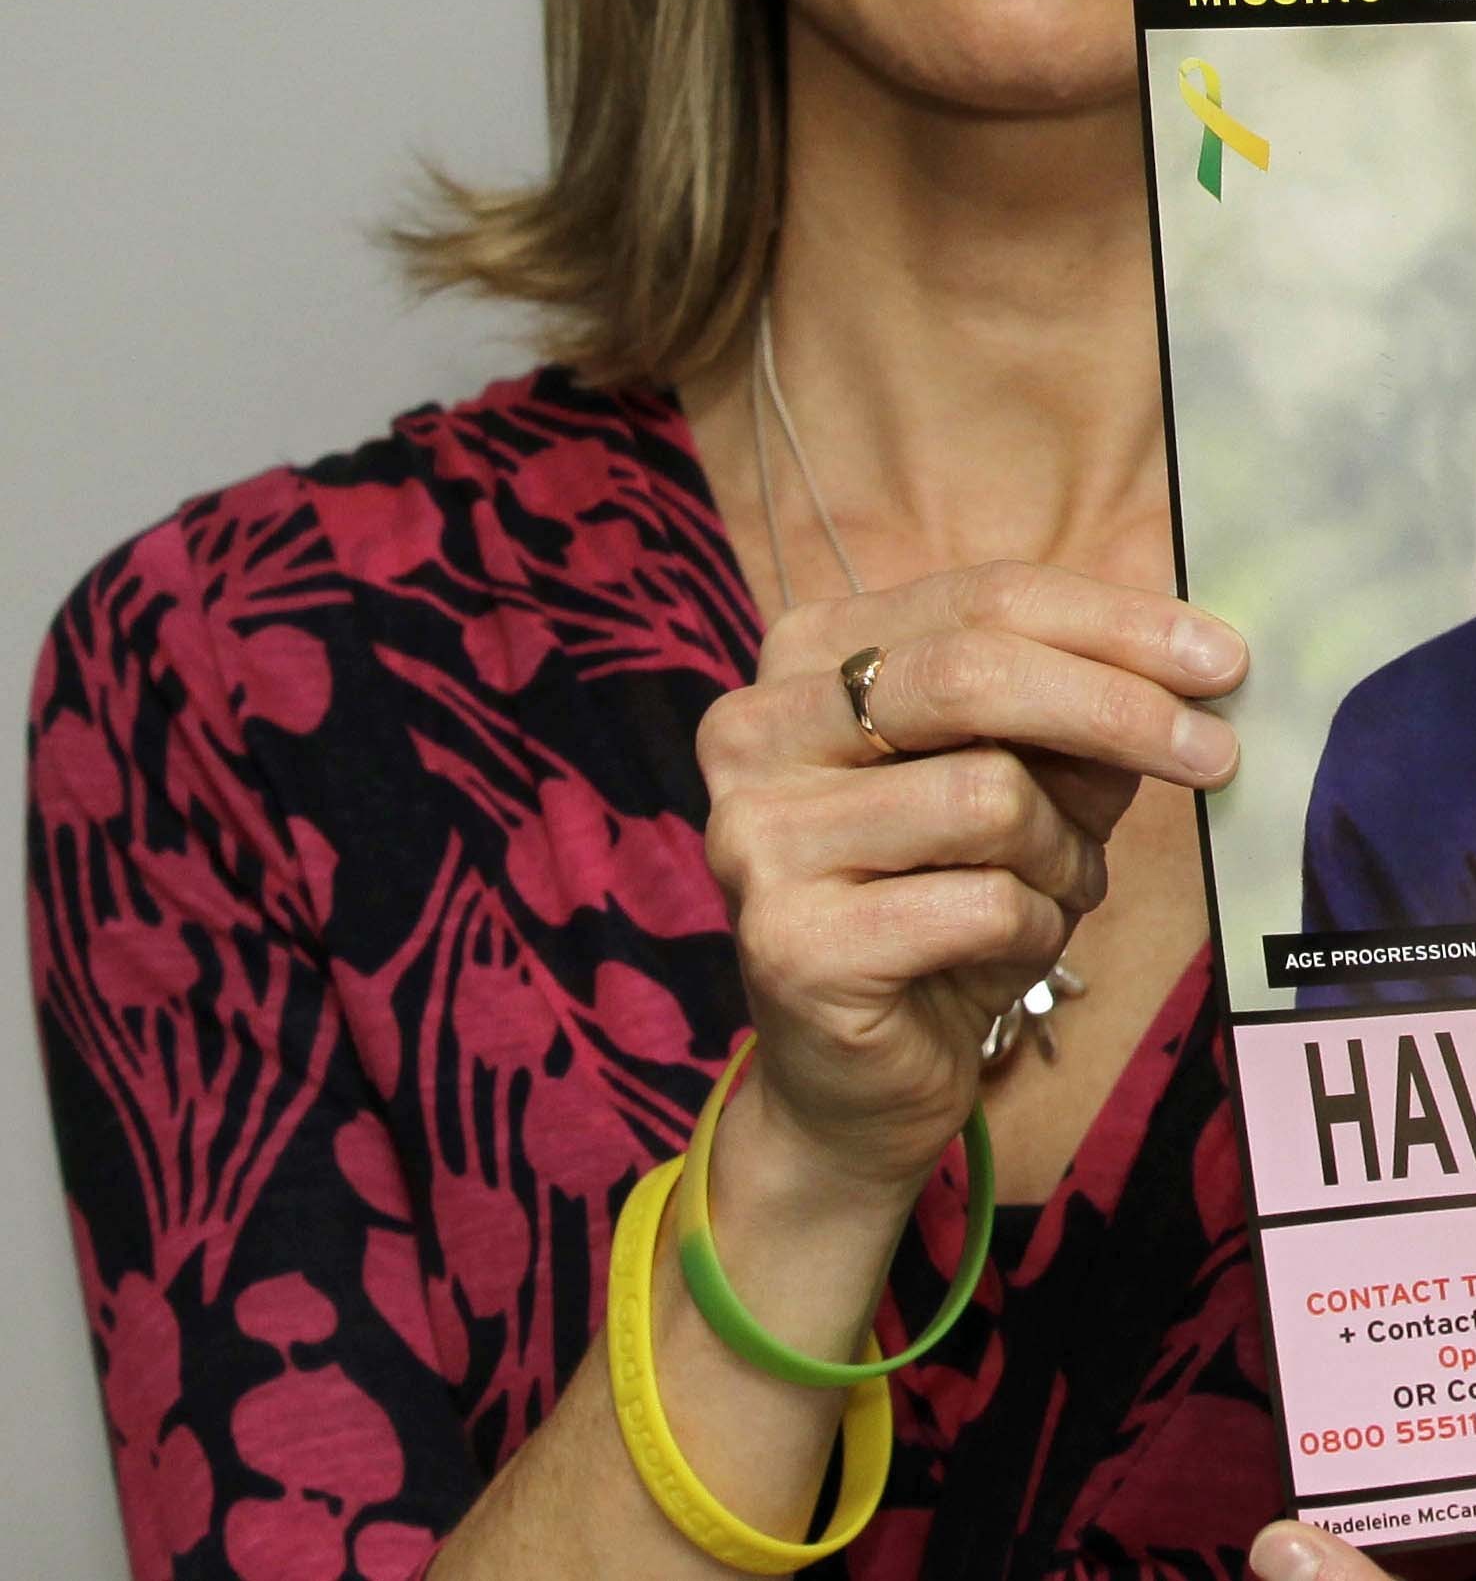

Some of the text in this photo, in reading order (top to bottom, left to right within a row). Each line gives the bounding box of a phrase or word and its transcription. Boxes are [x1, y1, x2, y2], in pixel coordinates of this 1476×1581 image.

[1285, 951, 1326, 970] AGE
[1331, 941, 1476, 967] PROGRESSION
[1306, 1277, 1451, 1316] CONTACT
[1339, 1327, 1356, 1344] +
[1393, 1383, 1437, 1409] OR
[1299, 1424, 1385, 1456] 0800
